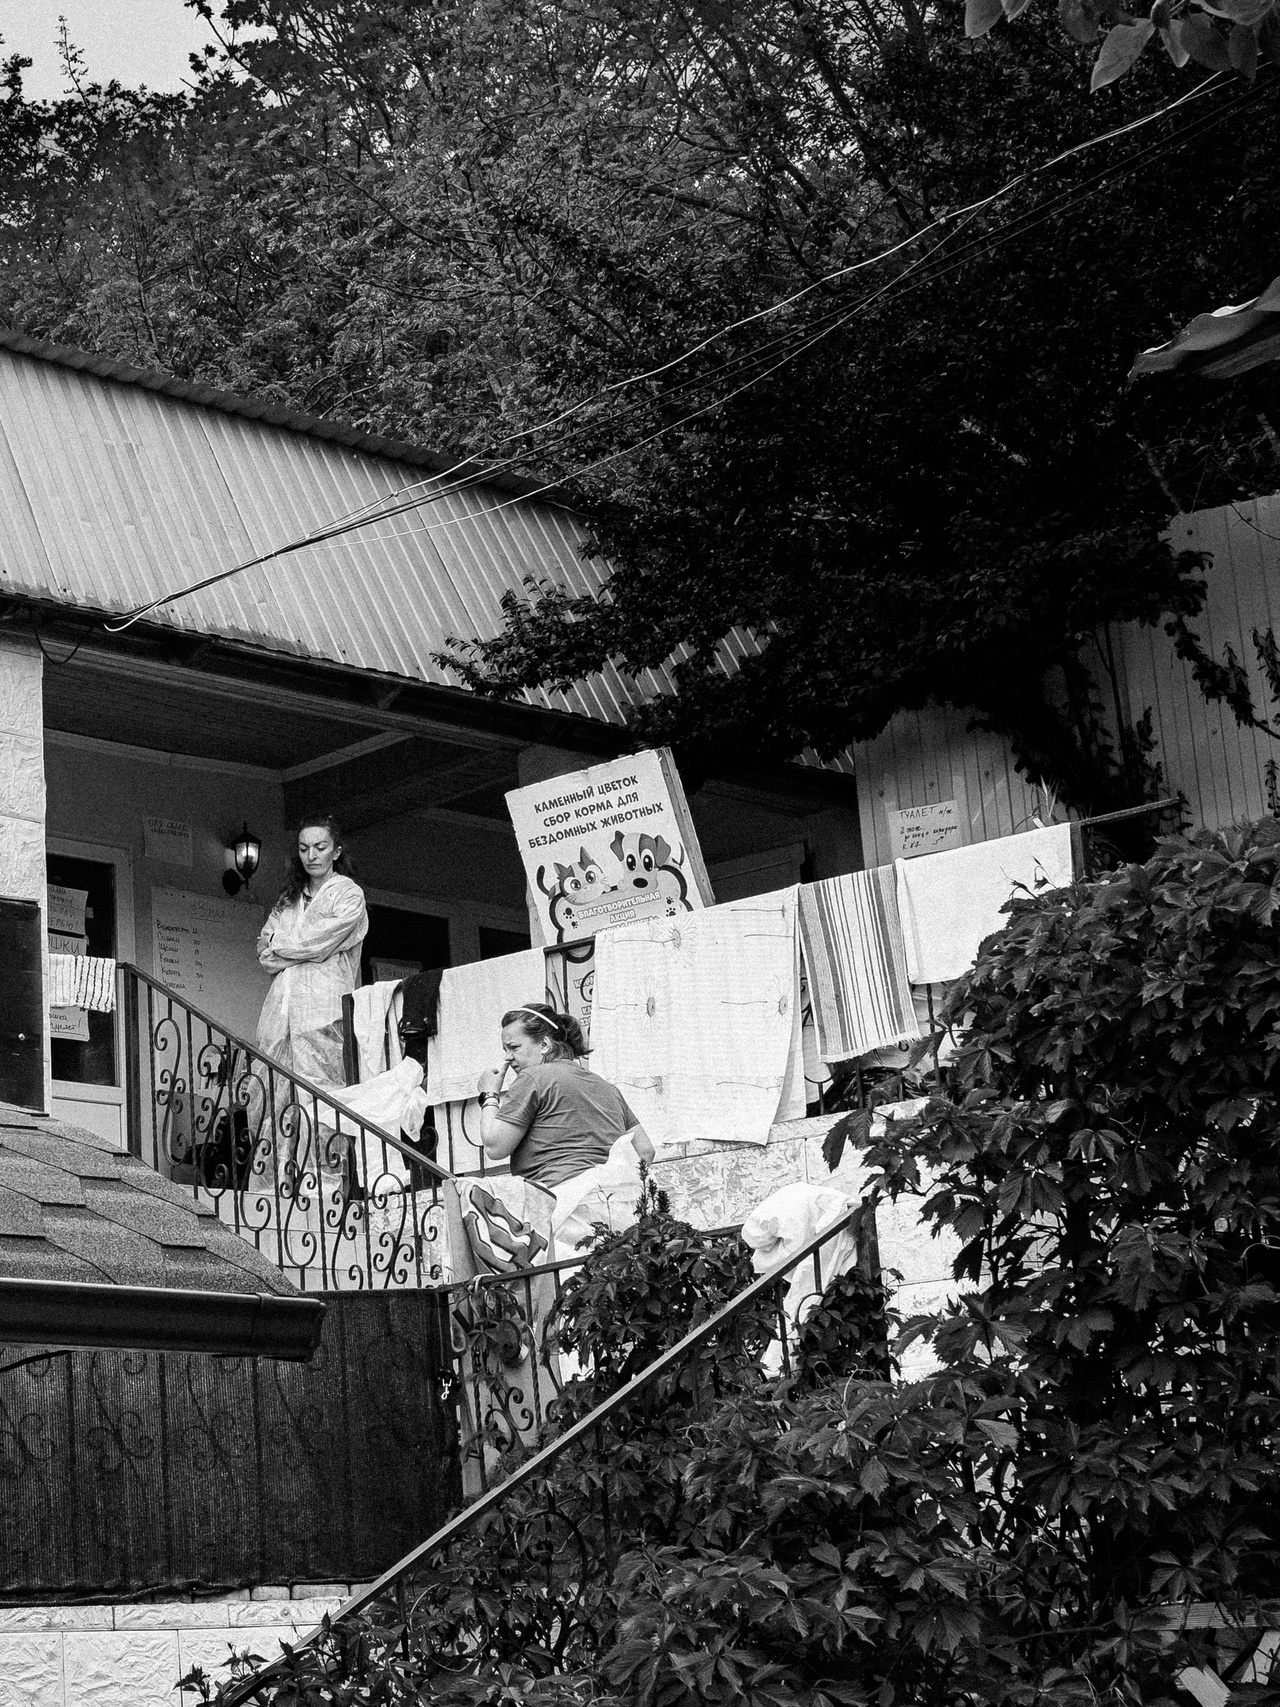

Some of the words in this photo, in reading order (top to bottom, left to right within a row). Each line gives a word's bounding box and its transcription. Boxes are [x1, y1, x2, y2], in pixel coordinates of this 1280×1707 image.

[534, 785, 595, 814] КАМЕННЫЙ
[597, 775, 639, 796] ЦВЕТОК
[543, 811, 571, 828] СБОР
[574, 799, 614, 819] КОРМА
[617, 791, 639, 808] ДЛЯ
[528, 821, 598, 849] БЕЗДОМНЫХ
[600, 802, 664, 829] ЖИВОТНЫХ
[899, 806, 938, 820] ТУАЛЕТ
[577, 890, 661, 921] БЛАГОТВОРИТЕЛЬНАЯ
[609, 909, 636, 923] АКЦИЯ
